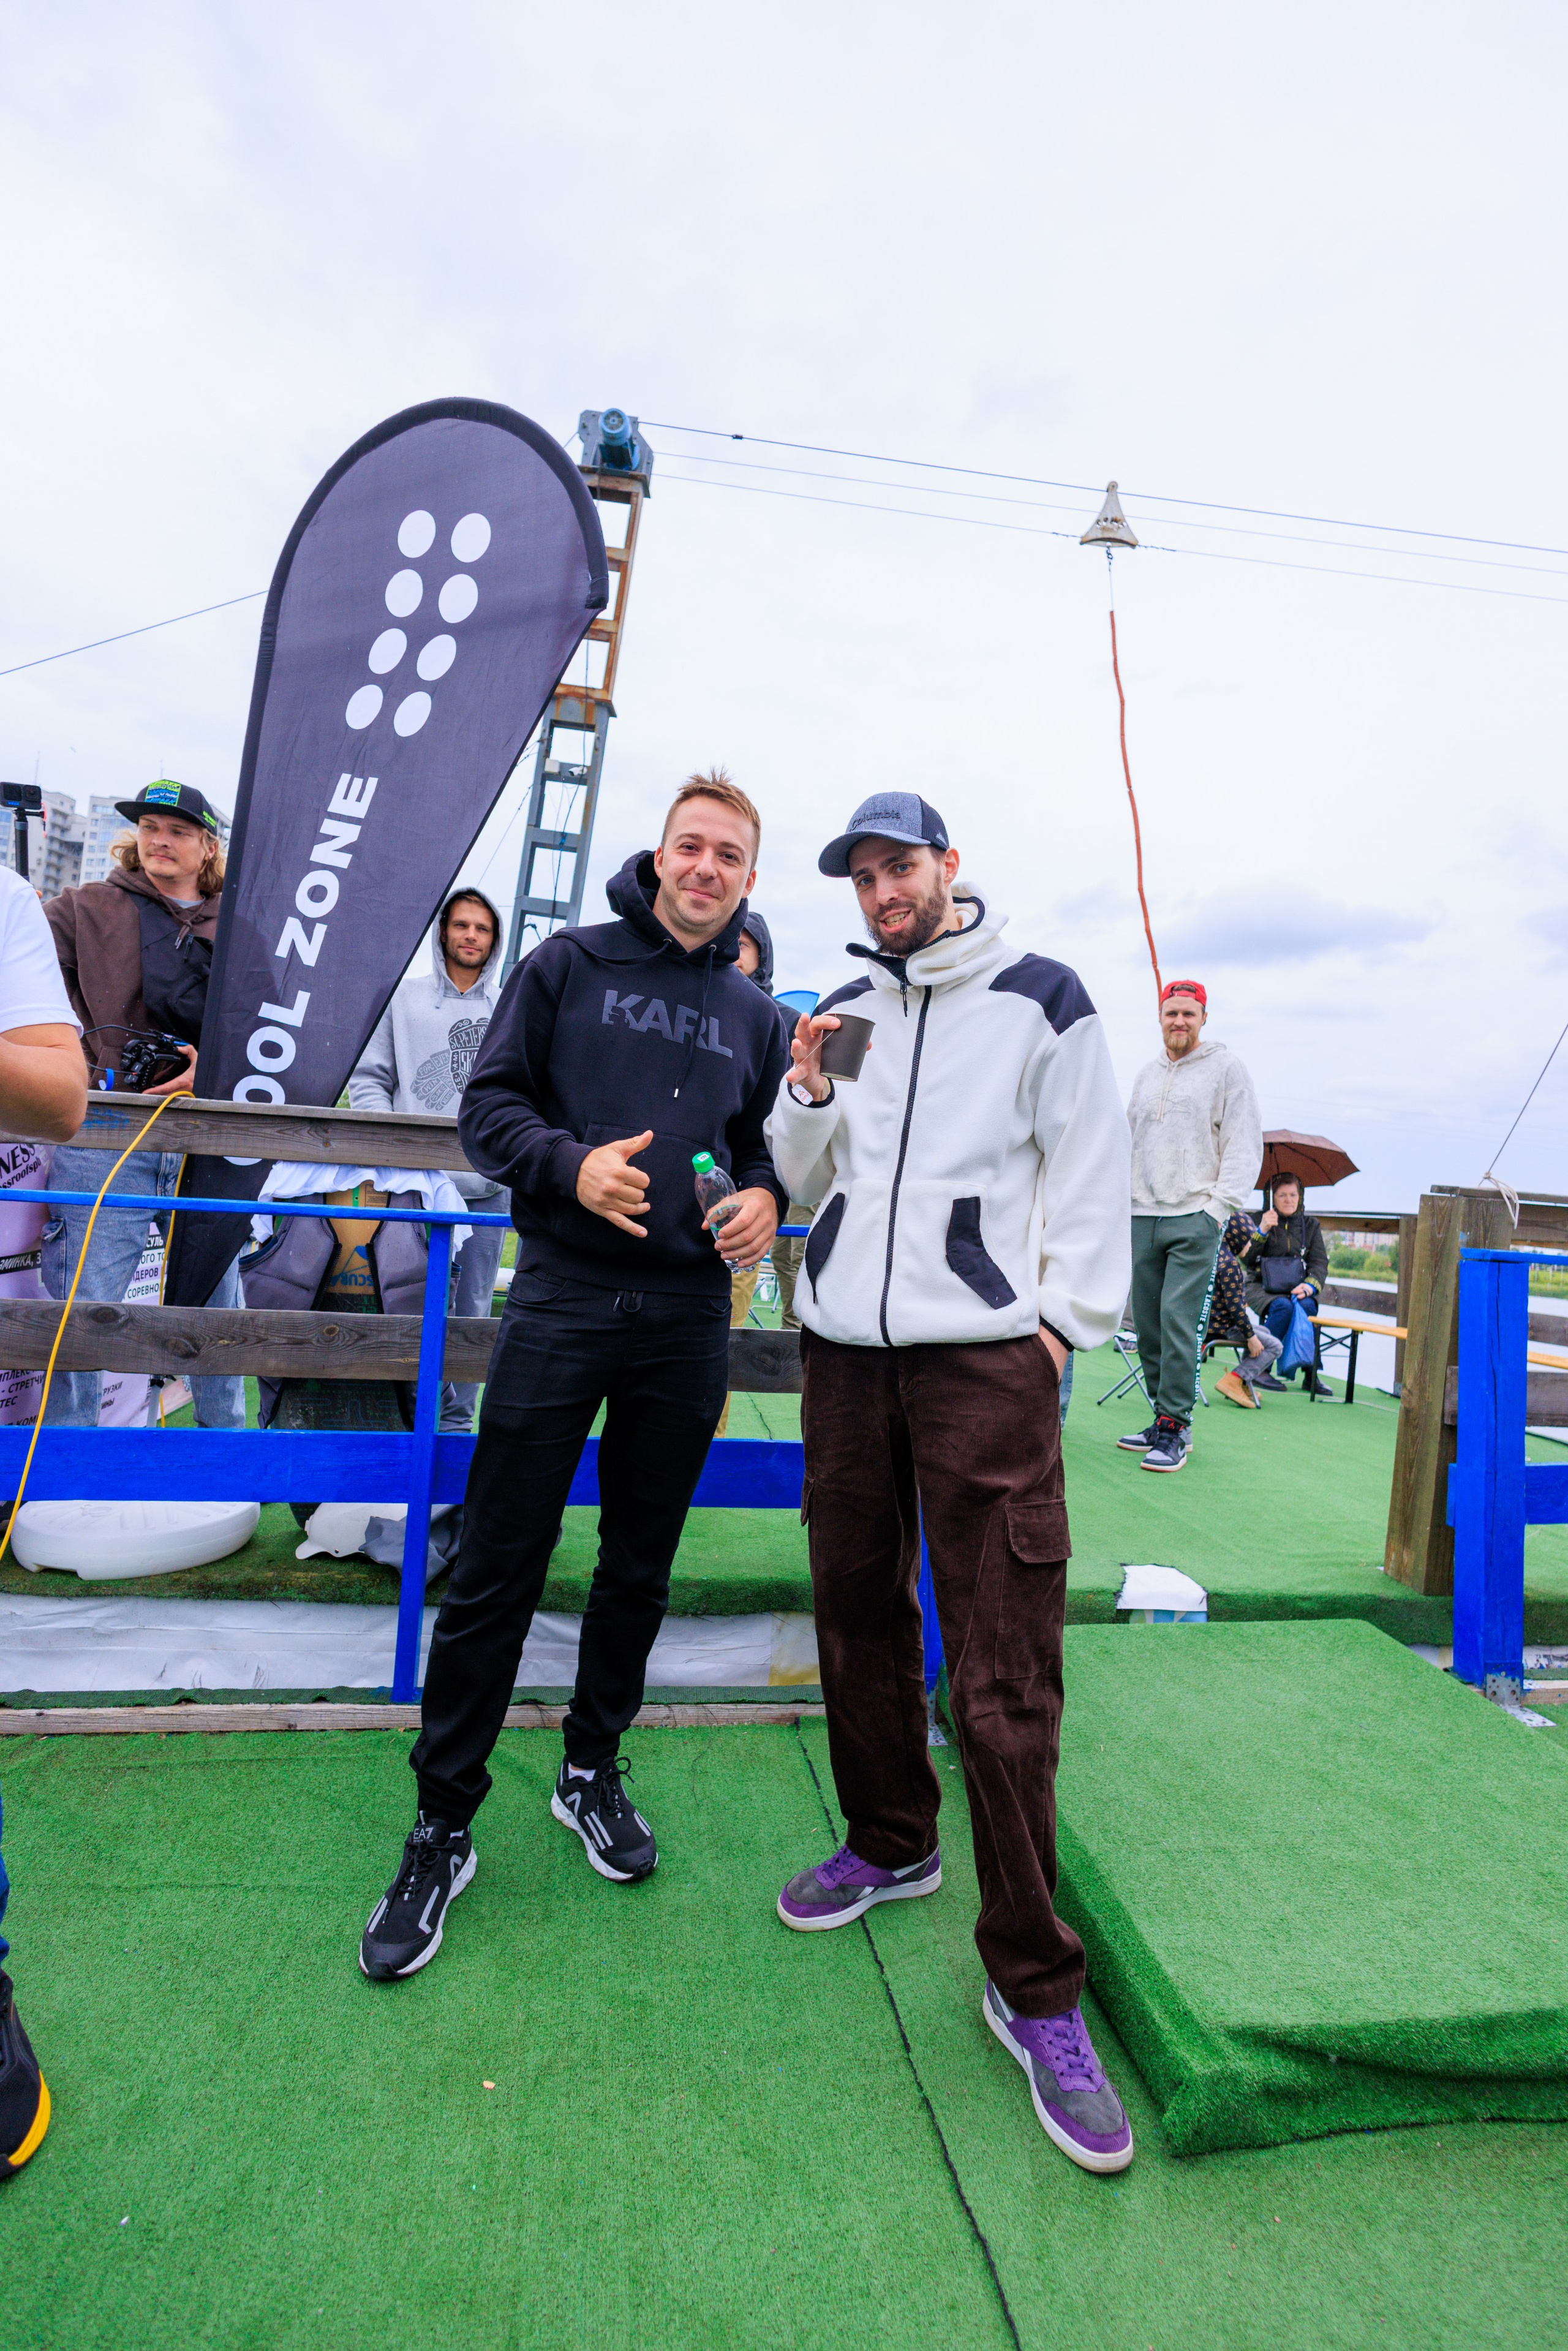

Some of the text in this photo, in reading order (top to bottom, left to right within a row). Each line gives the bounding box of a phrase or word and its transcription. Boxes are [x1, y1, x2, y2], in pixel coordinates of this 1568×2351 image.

[223, 773, 379, 1165] OOL ZONE
[601, 989, 733, 1059] KARL
[0, 1157, 42, 1188] ssroofspb
[1199, 1294, 1212, 1322] LACOSTE
[413, 1827, 434, 1839] EA7
